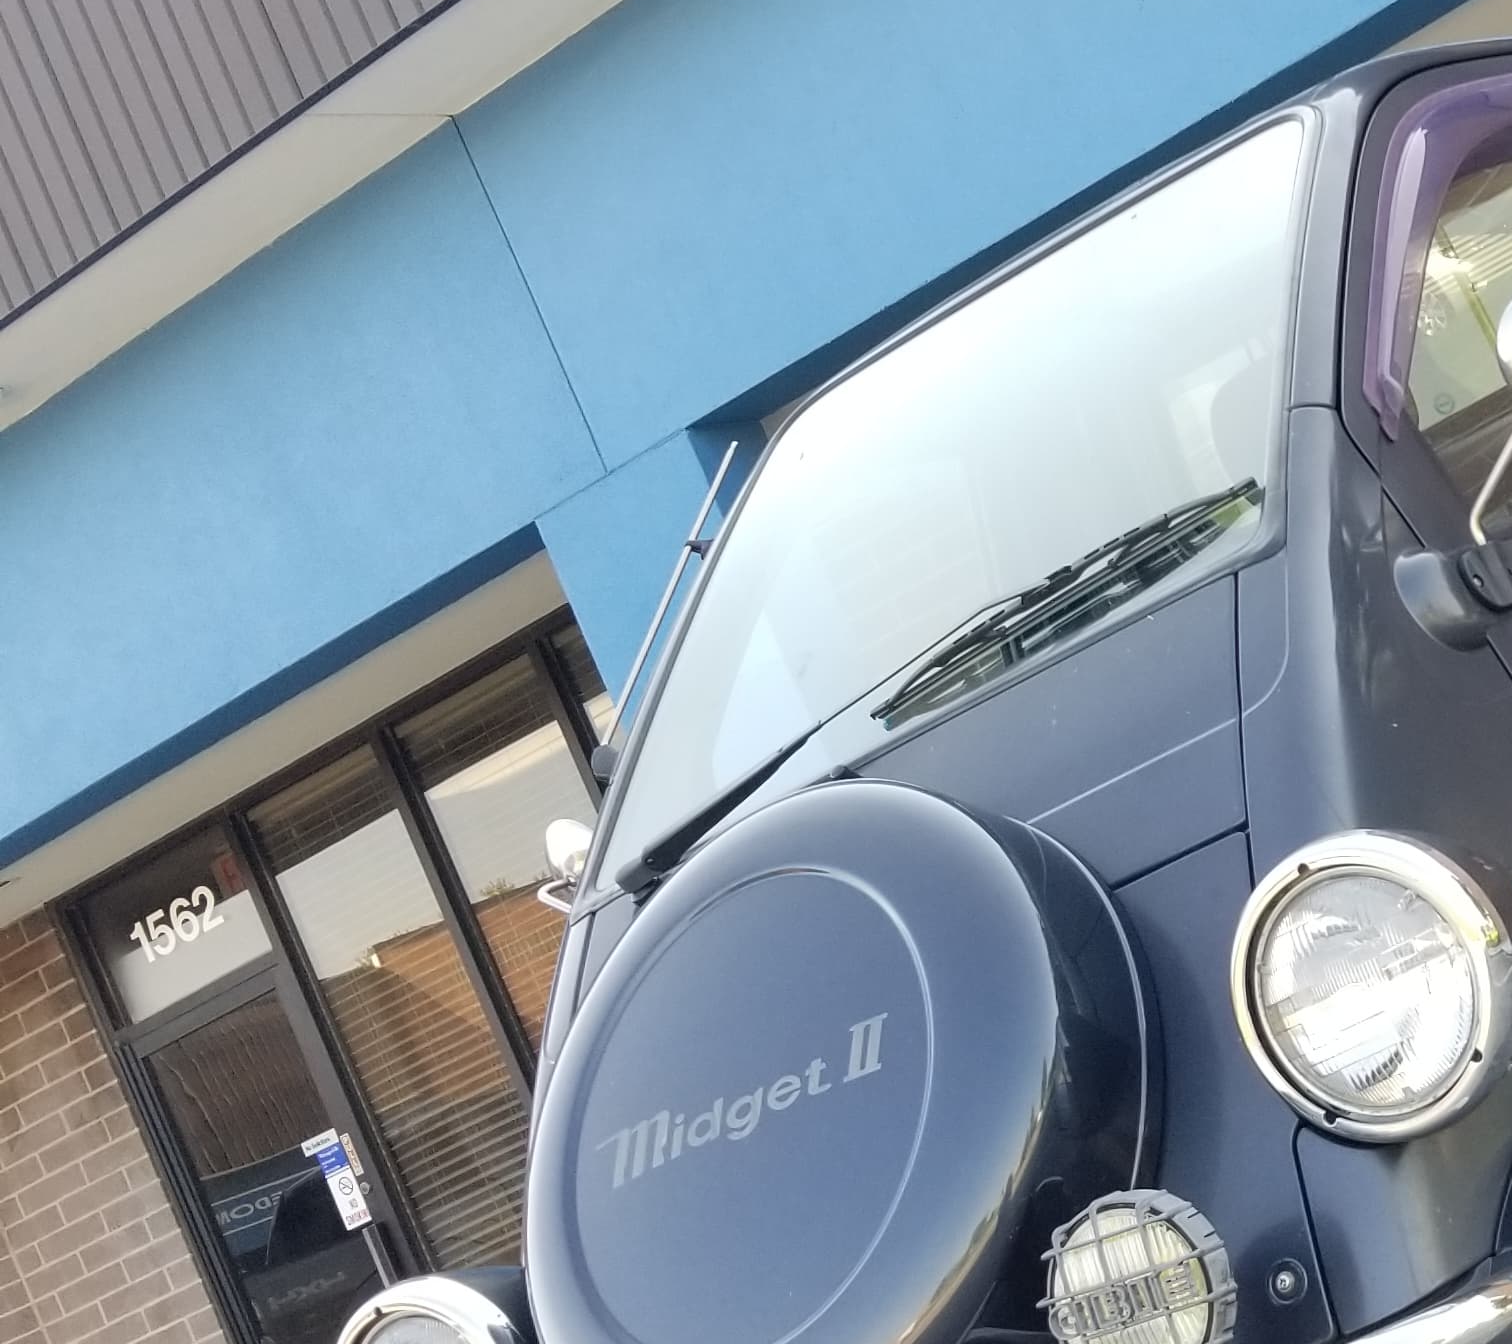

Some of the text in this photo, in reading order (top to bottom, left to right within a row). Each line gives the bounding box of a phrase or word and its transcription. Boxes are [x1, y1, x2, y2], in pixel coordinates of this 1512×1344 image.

[129, 885, 225, 963] 1562
[594, 1012, 889, 1190] Midget II
